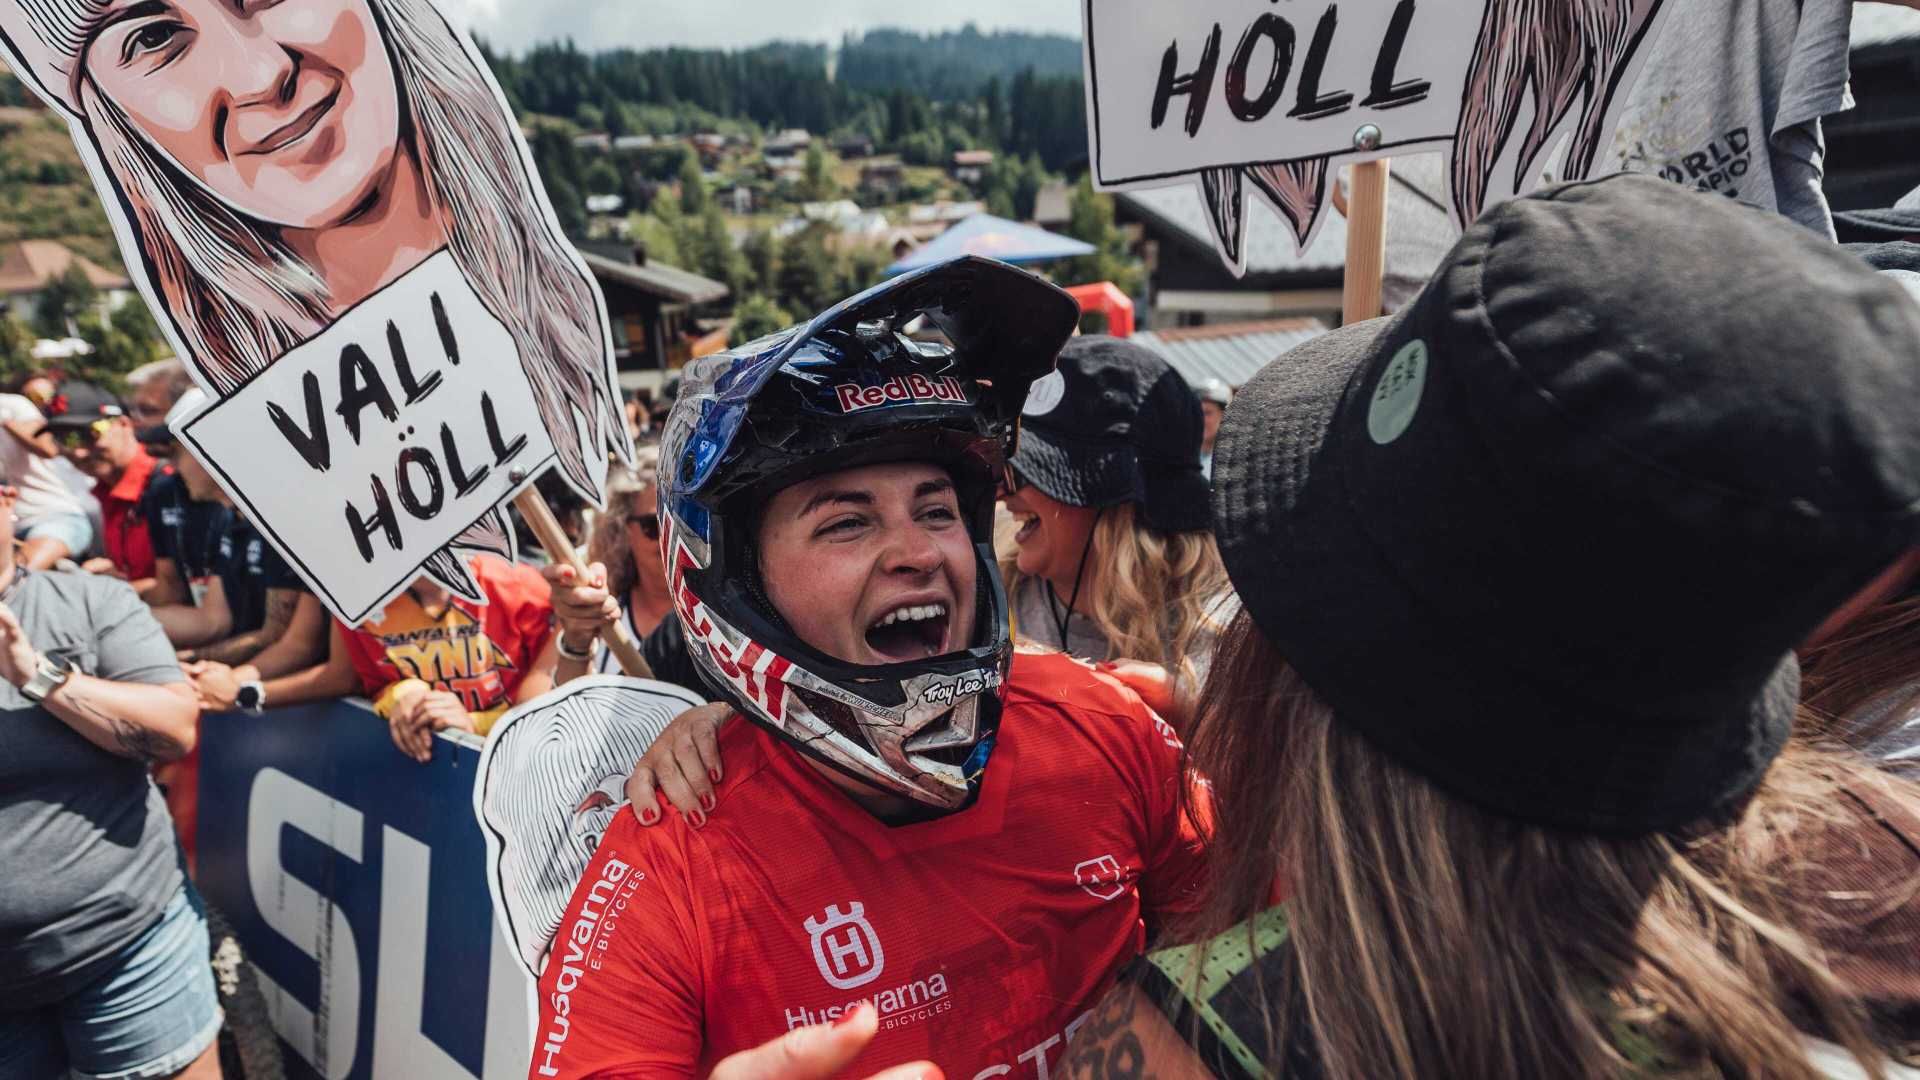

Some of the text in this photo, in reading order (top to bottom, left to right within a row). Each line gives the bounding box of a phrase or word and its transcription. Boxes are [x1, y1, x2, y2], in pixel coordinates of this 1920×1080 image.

[1658, 126, 1750, 184] ORLD
[266, 290, 461, 473] VALI
[834, 373, 968, 414] Red Bull
[345, 390, 528, 564] HÖLL
[923, 681, 955, 706] Troy
[954, 677, 984, 697] Lee
[590, 870, 645, 971] E-BICYCLES
[875, 1000, 952, 1032] -BICYCLES
